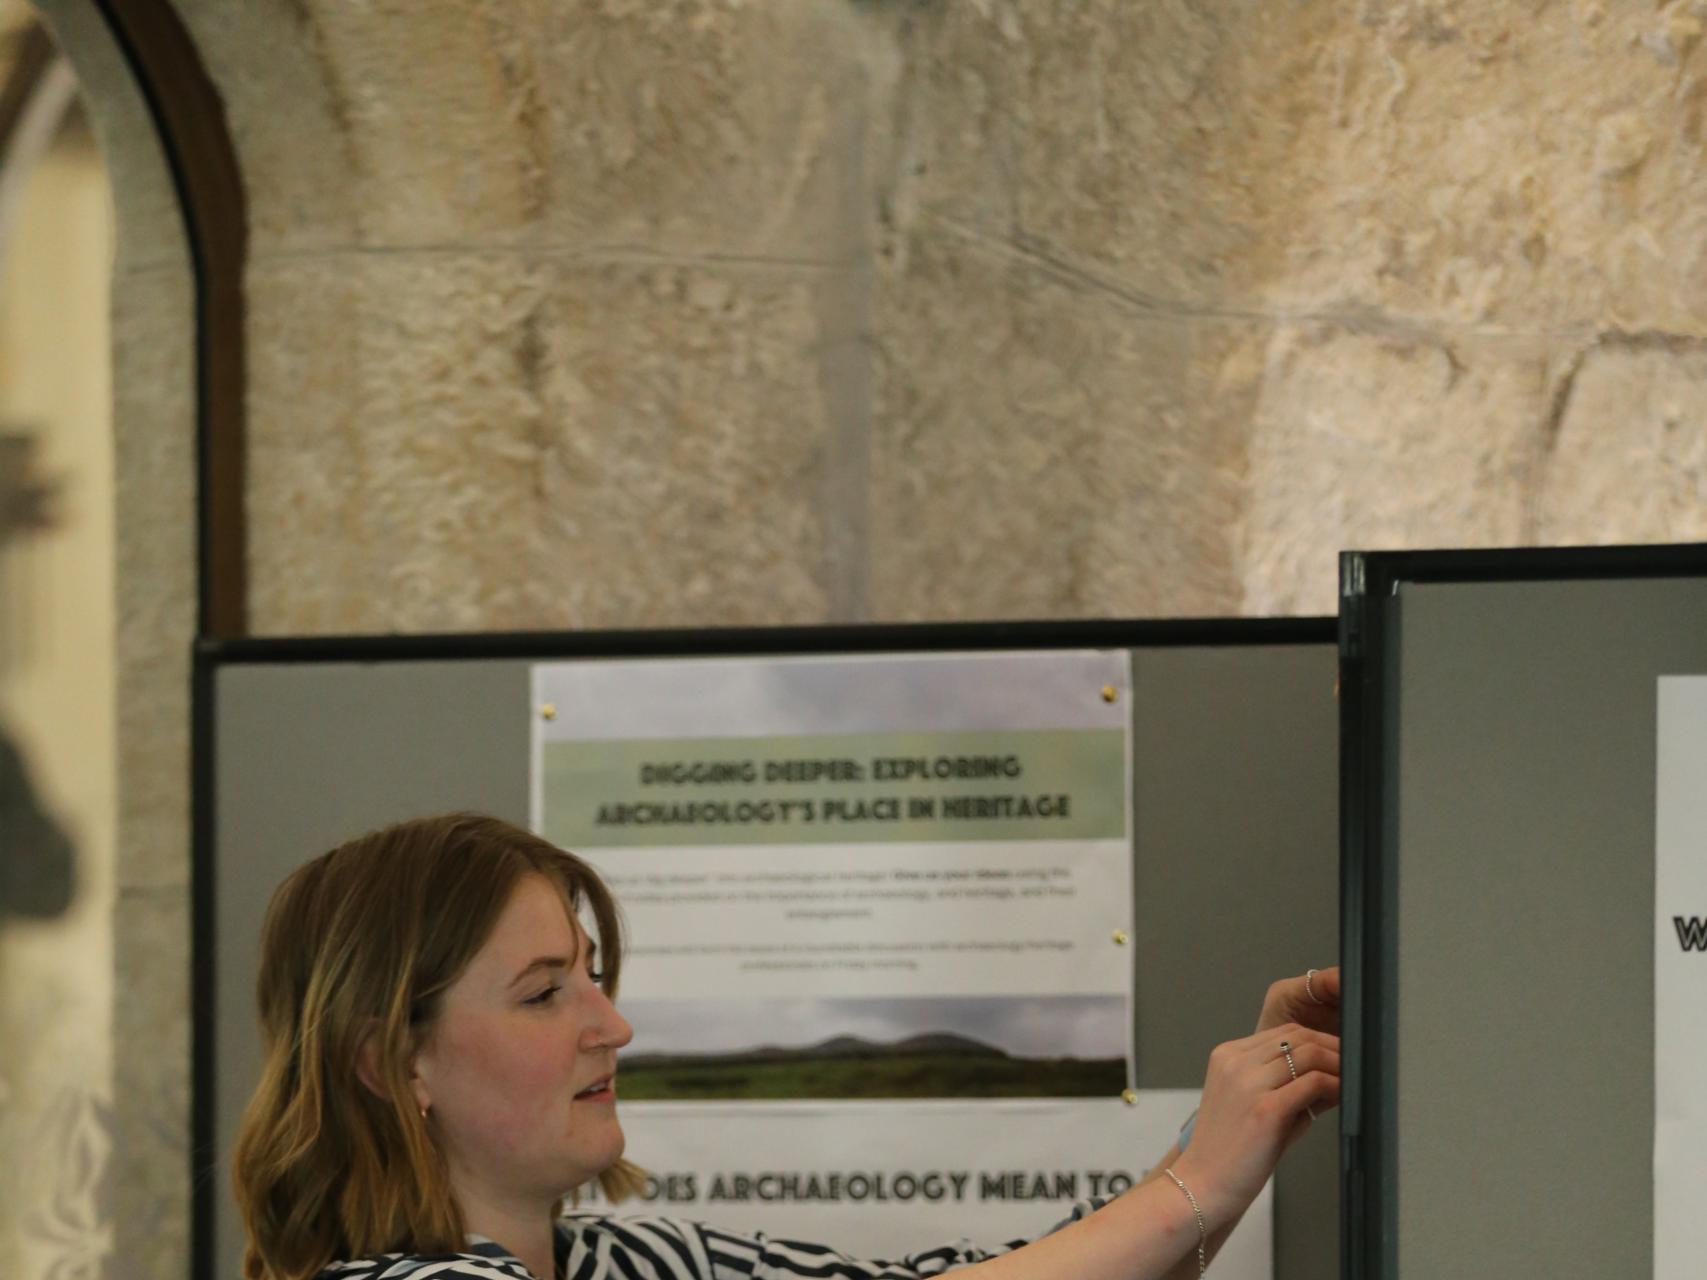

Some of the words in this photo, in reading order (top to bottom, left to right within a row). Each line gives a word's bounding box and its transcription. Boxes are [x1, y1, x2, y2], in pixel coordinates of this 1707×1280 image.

[640, 762, 757, 785] DIGGING
[764, 759, 866, 783] DEEPER:
[873, 755, 1021, 781] EXPLORING
[595, 799, 815, 825] ARCHAEOLOGY'S
[821, 797, 900, 821] PLACE
[908, 797, 934, 820] IN
[943, 794, 1071, 819] HERITAGE
[642, 1175, 697, 1202] OES
[707, 1173, 969, 1201] ARCHAEOLOGY
[981, 1173, 1076, 1200] MEAN
[1087, 1172, 1133, 1200] TO
